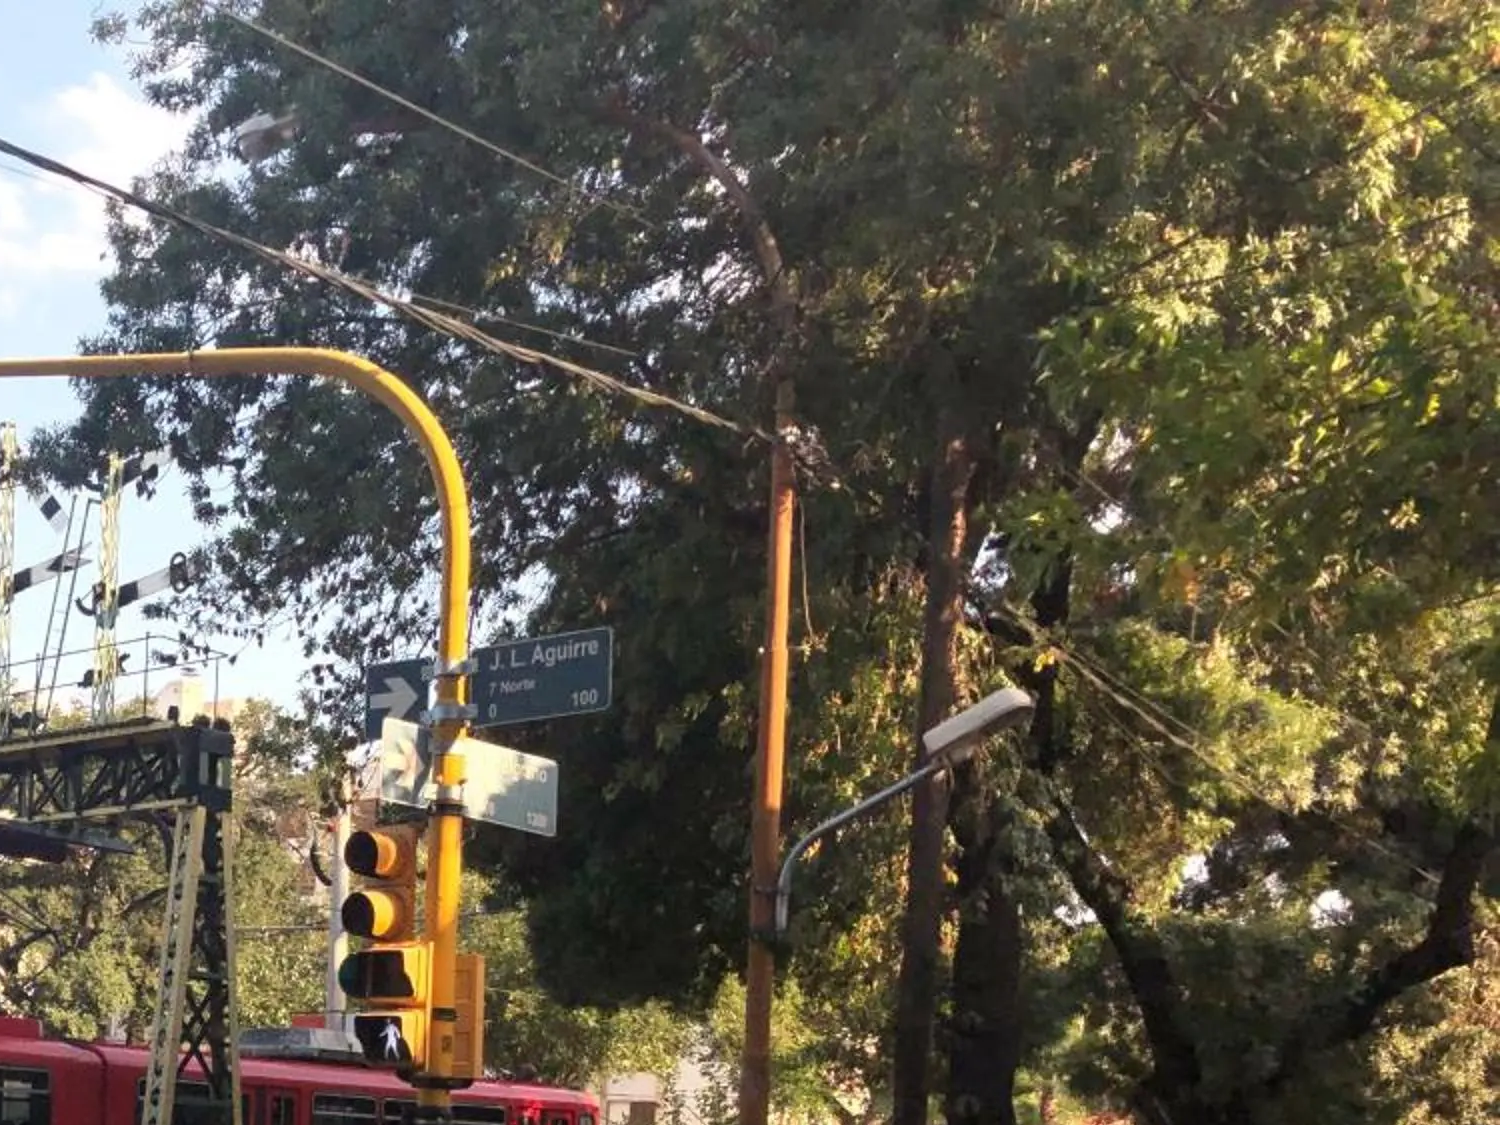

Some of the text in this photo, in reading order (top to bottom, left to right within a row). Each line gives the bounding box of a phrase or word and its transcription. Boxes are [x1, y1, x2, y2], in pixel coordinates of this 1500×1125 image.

[489, 649, 505, 671] J.
[531, 638, 599, 667] Aguirre
[571, 687, 599, 707] 100
